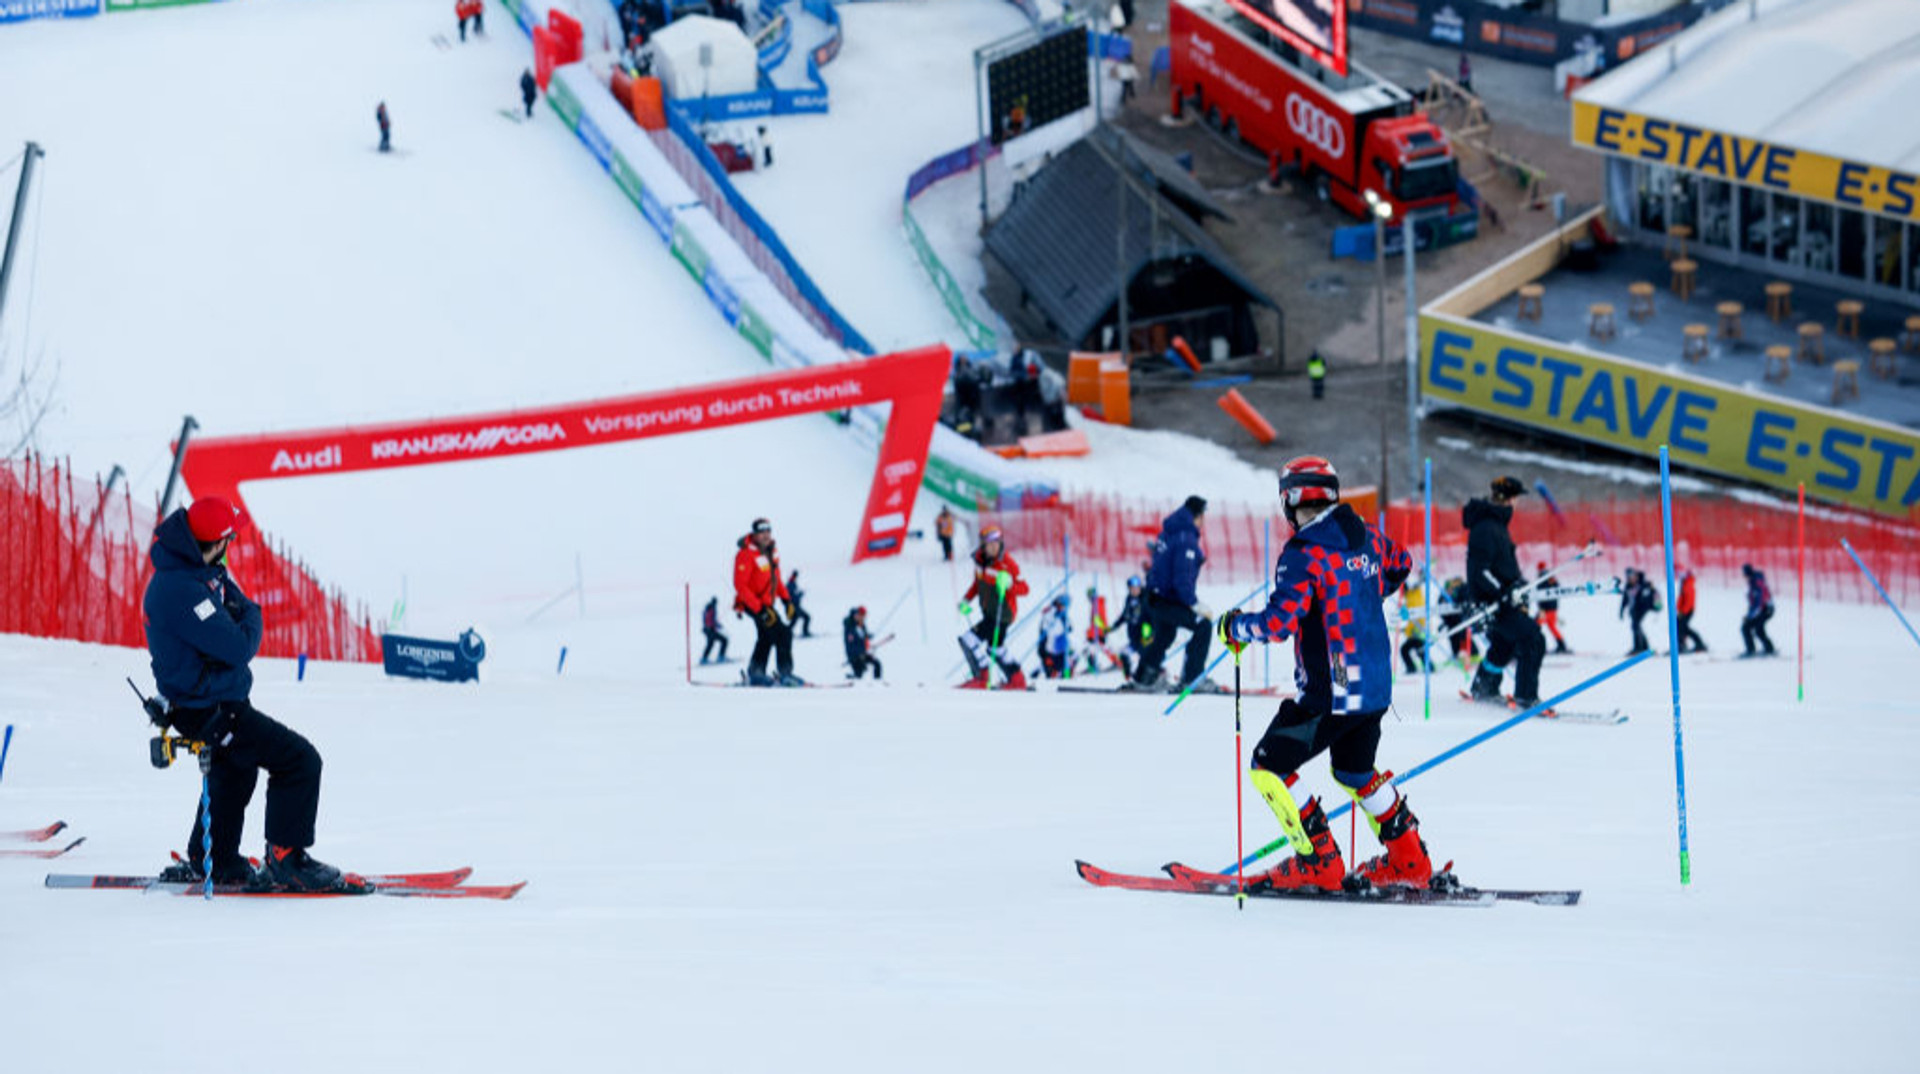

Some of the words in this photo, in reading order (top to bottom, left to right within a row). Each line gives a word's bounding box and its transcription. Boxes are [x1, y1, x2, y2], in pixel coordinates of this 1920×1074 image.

[271, 445, 342, 472] Audi
[505, 423, 566, 445] GORA
[583, 404, 703, 435] Vorsprung
[708, 394, 774, 418] durch
[777, 379, 862, 406] Technik
[396, 644, 456, 663] LONGINES
